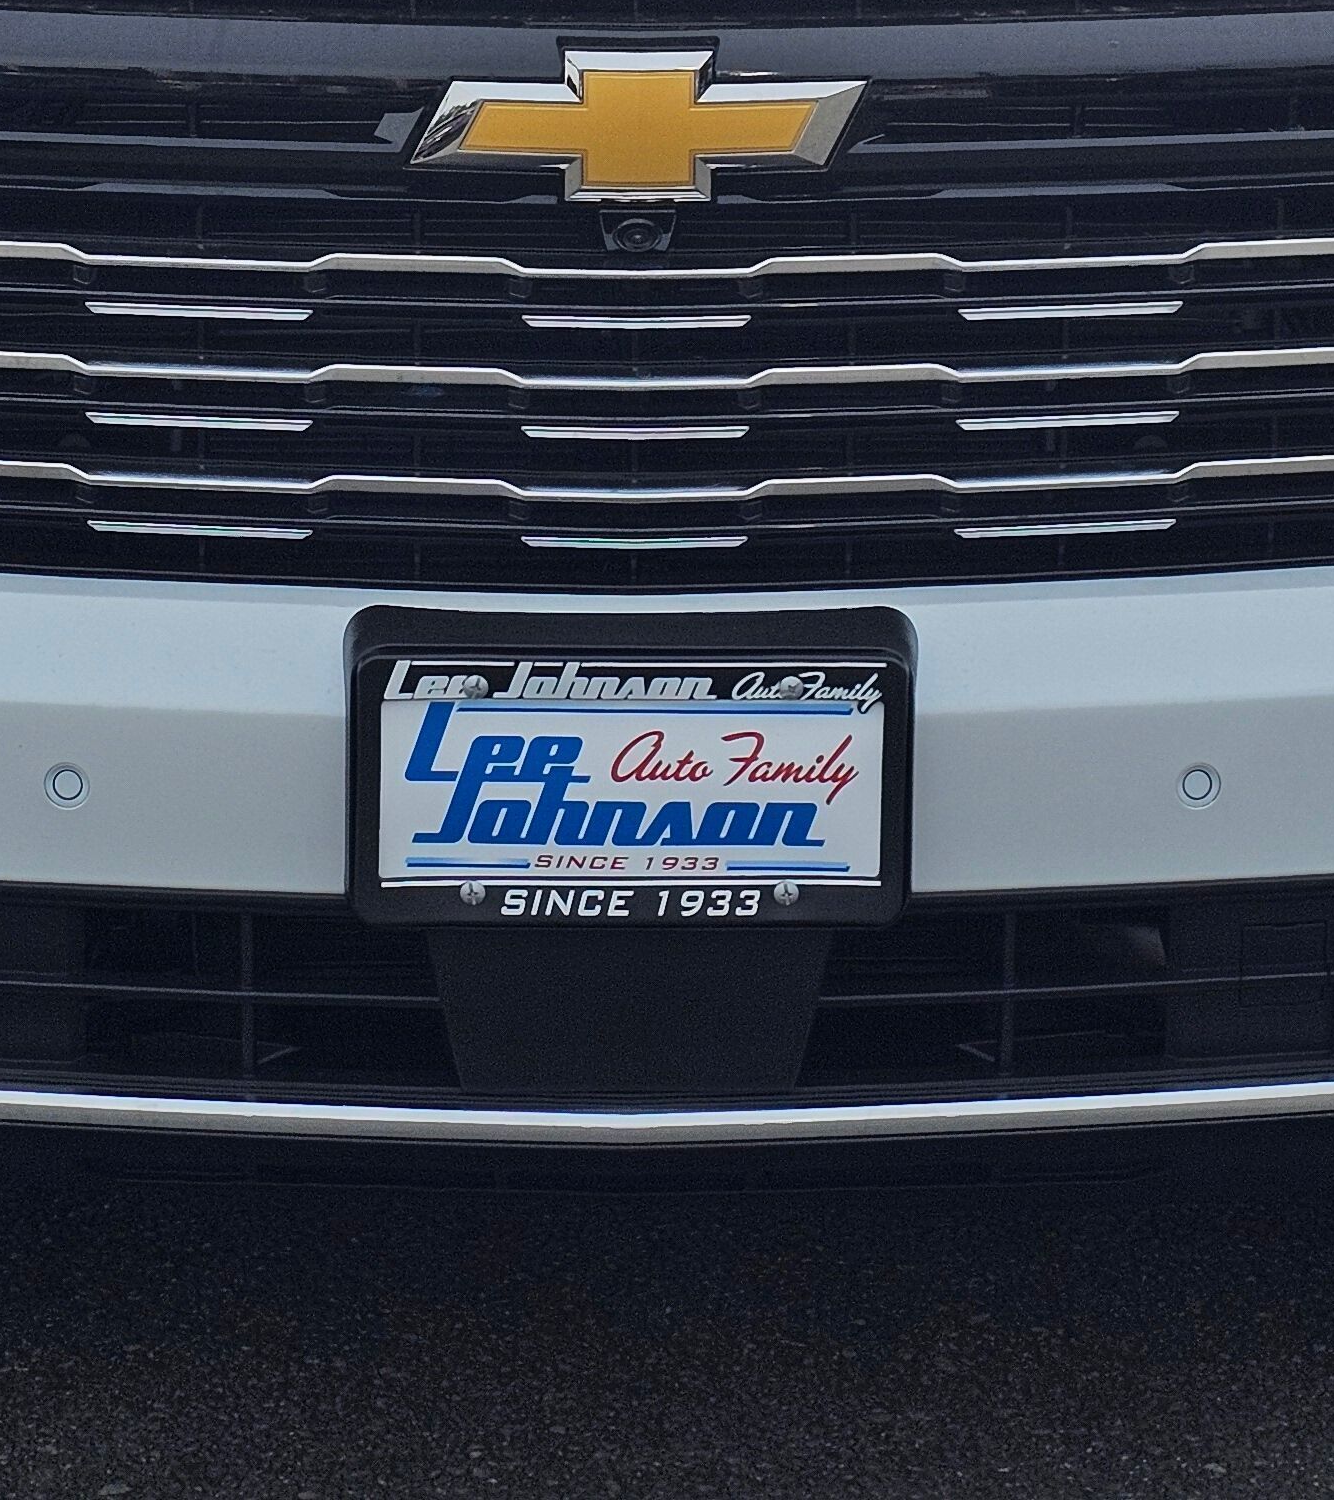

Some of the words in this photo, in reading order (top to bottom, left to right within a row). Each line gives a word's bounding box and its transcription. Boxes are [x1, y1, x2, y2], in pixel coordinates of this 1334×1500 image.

[492, 661, 718, 700] Johnson
[731, 671, 787, 701] Aut
[798, 671, 883, 713] Family
[404, 702, 591, 783] Lee
[609, 729, 714, 786] Auto
[721, 730, 860, 805] Family
[411, 777, 826, 847] Johnson
[533, 855, 630, 870] SINCE
[644, 856, 720, 871] 1933
[499, 888, 635, 918] SINCE
[654, 888, 762, 918] 1933
